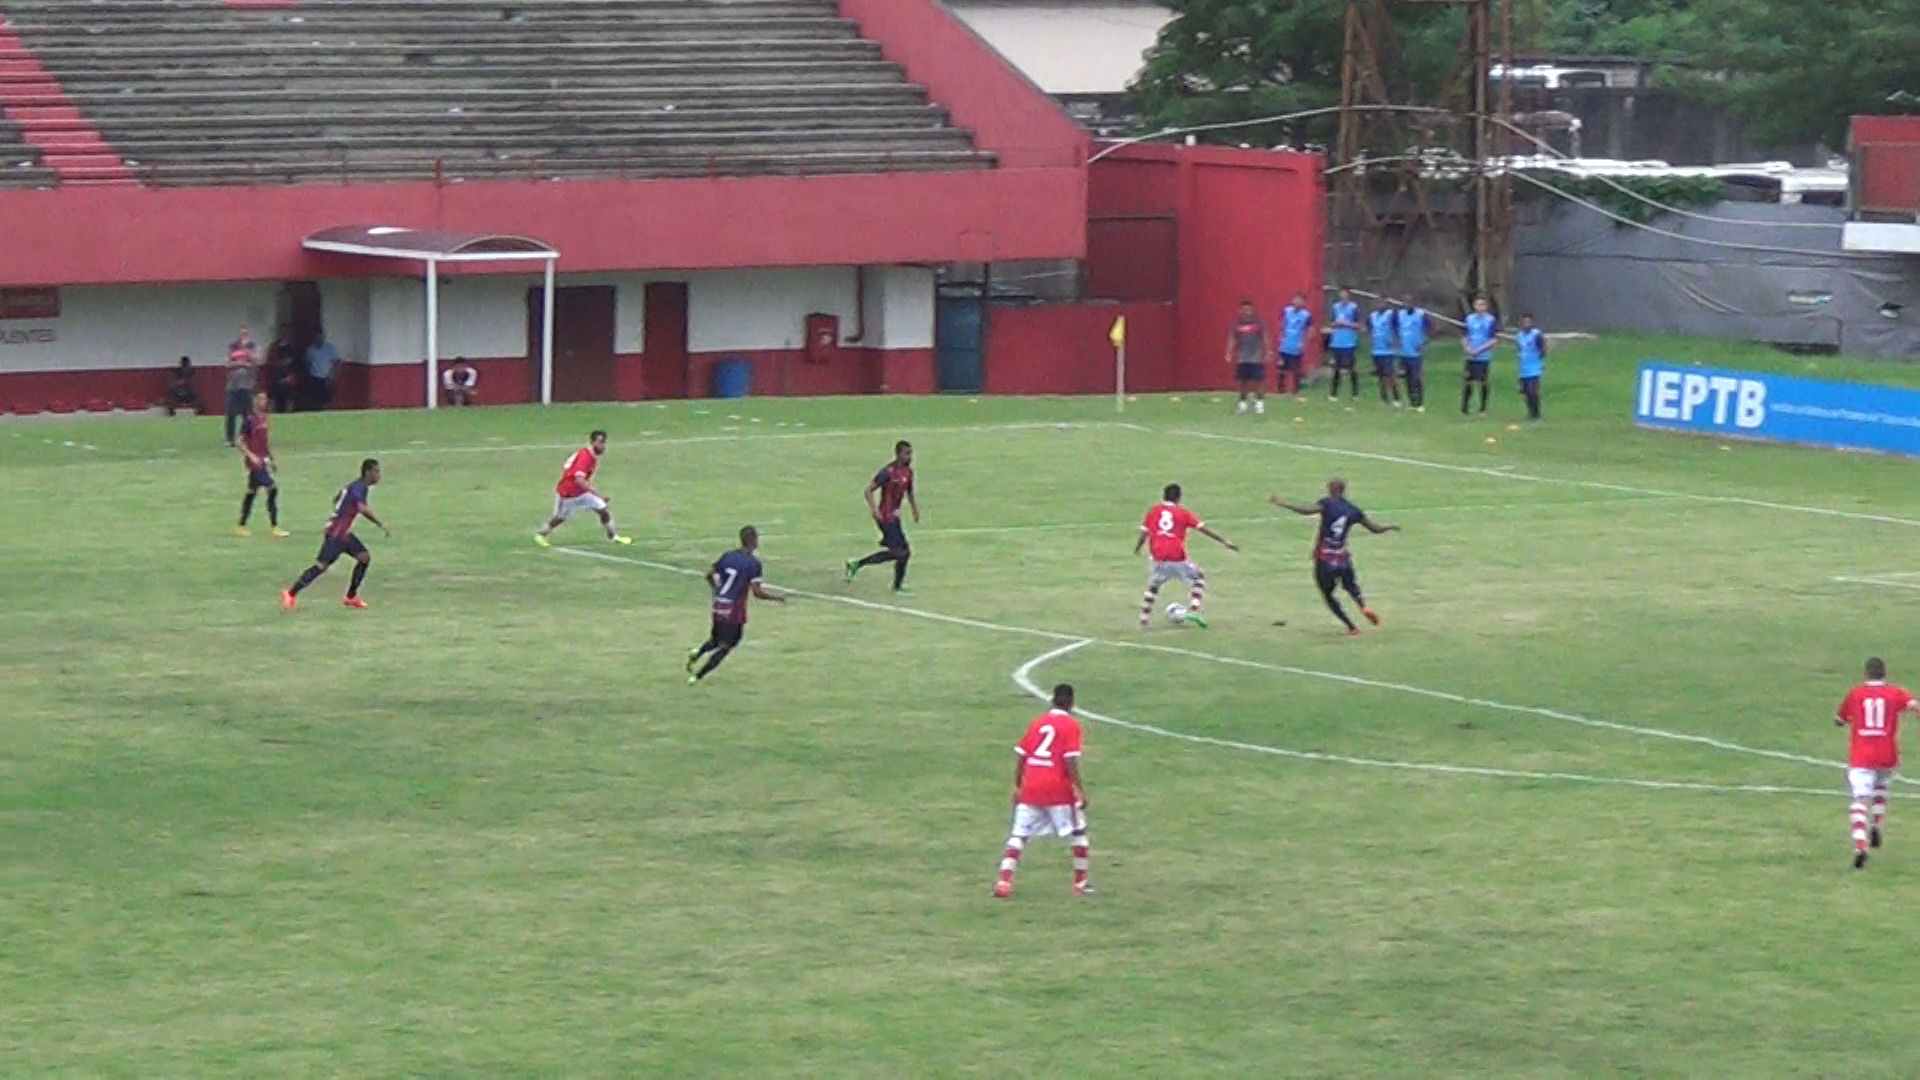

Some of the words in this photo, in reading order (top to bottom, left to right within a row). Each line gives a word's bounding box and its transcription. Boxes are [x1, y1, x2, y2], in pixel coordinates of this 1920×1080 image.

[1638, 369, 1766, 427] IEPTB
[1158, 510, 1173, 530] 8
[1331, 516, 1346, 538] 4
[720, 567, 737, 595] 7
[1863, 698, 1885, 728] 11
[1034, 725, 1054, 756] 2
